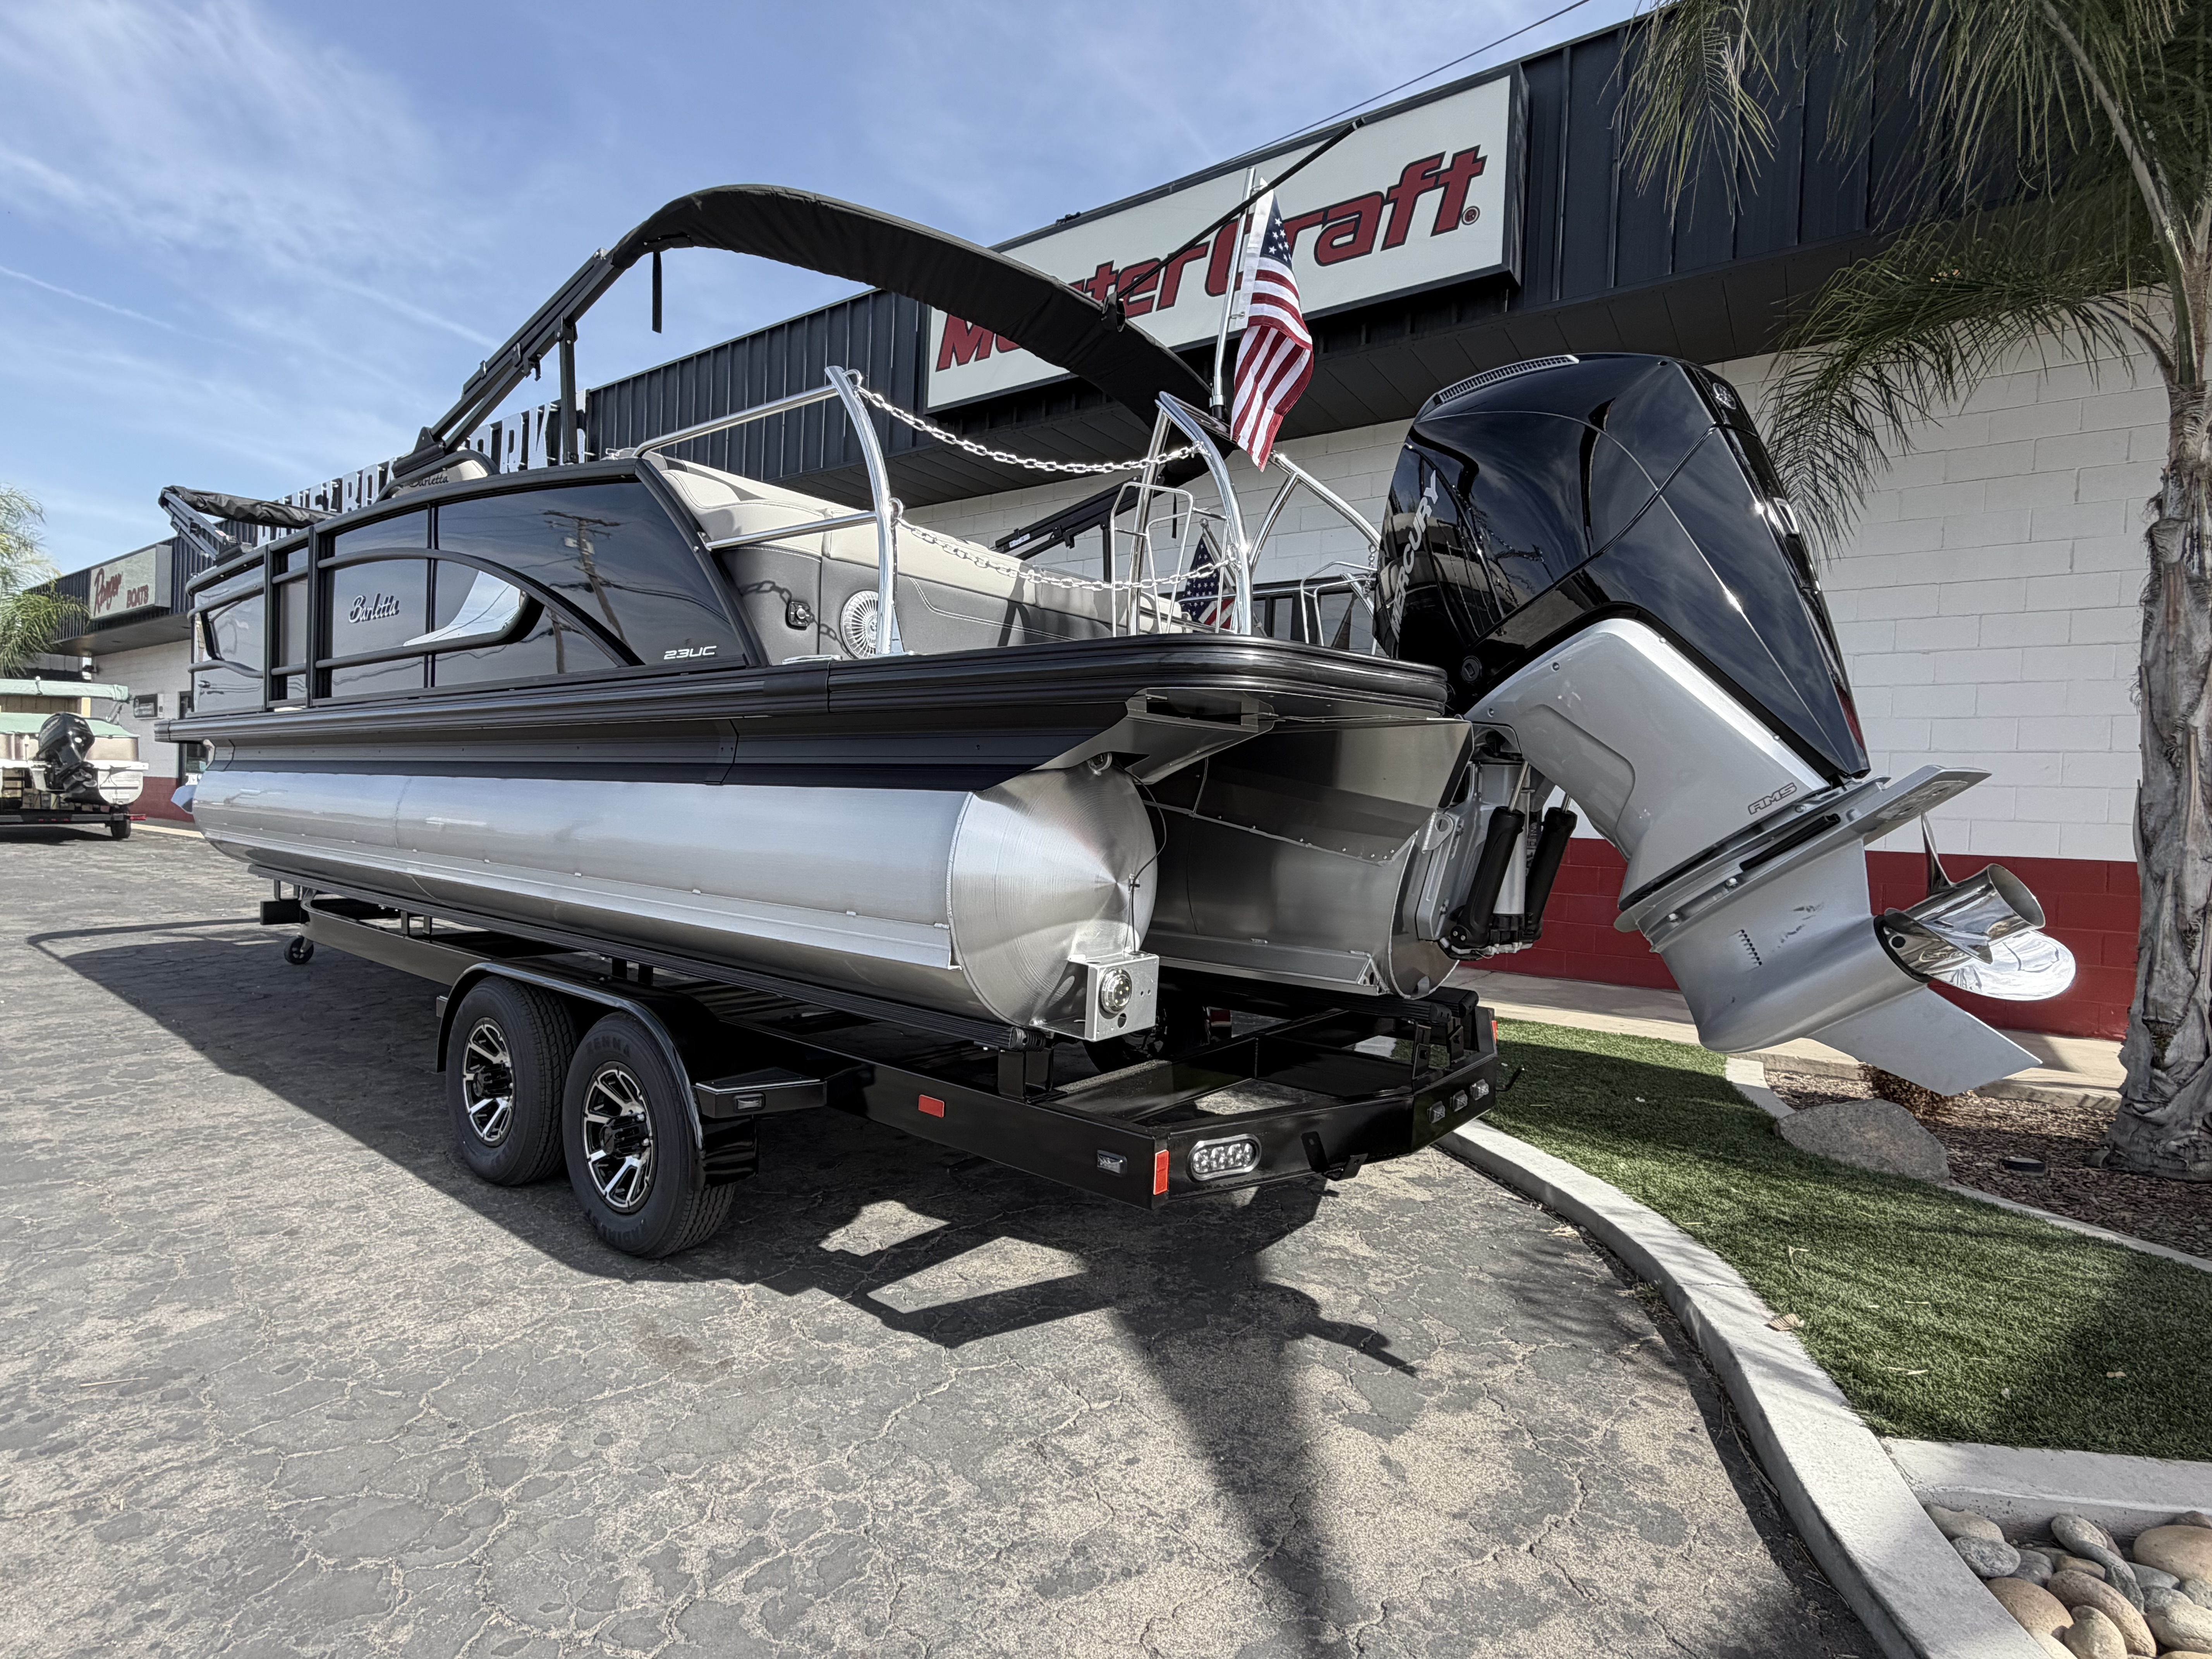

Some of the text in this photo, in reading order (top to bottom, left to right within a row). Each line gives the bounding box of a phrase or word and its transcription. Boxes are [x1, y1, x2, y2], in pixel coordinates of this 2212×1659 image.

[410, 473, 449, 488] arletta
[1391, 469, 1438, 644] MERCURY
[126, 584, 149, 609] BOATS
[349, 593, 400, 623] Barletta
[663, 646, 717, 660] 23UC
[1748, 782, 1797, 815] AMS
